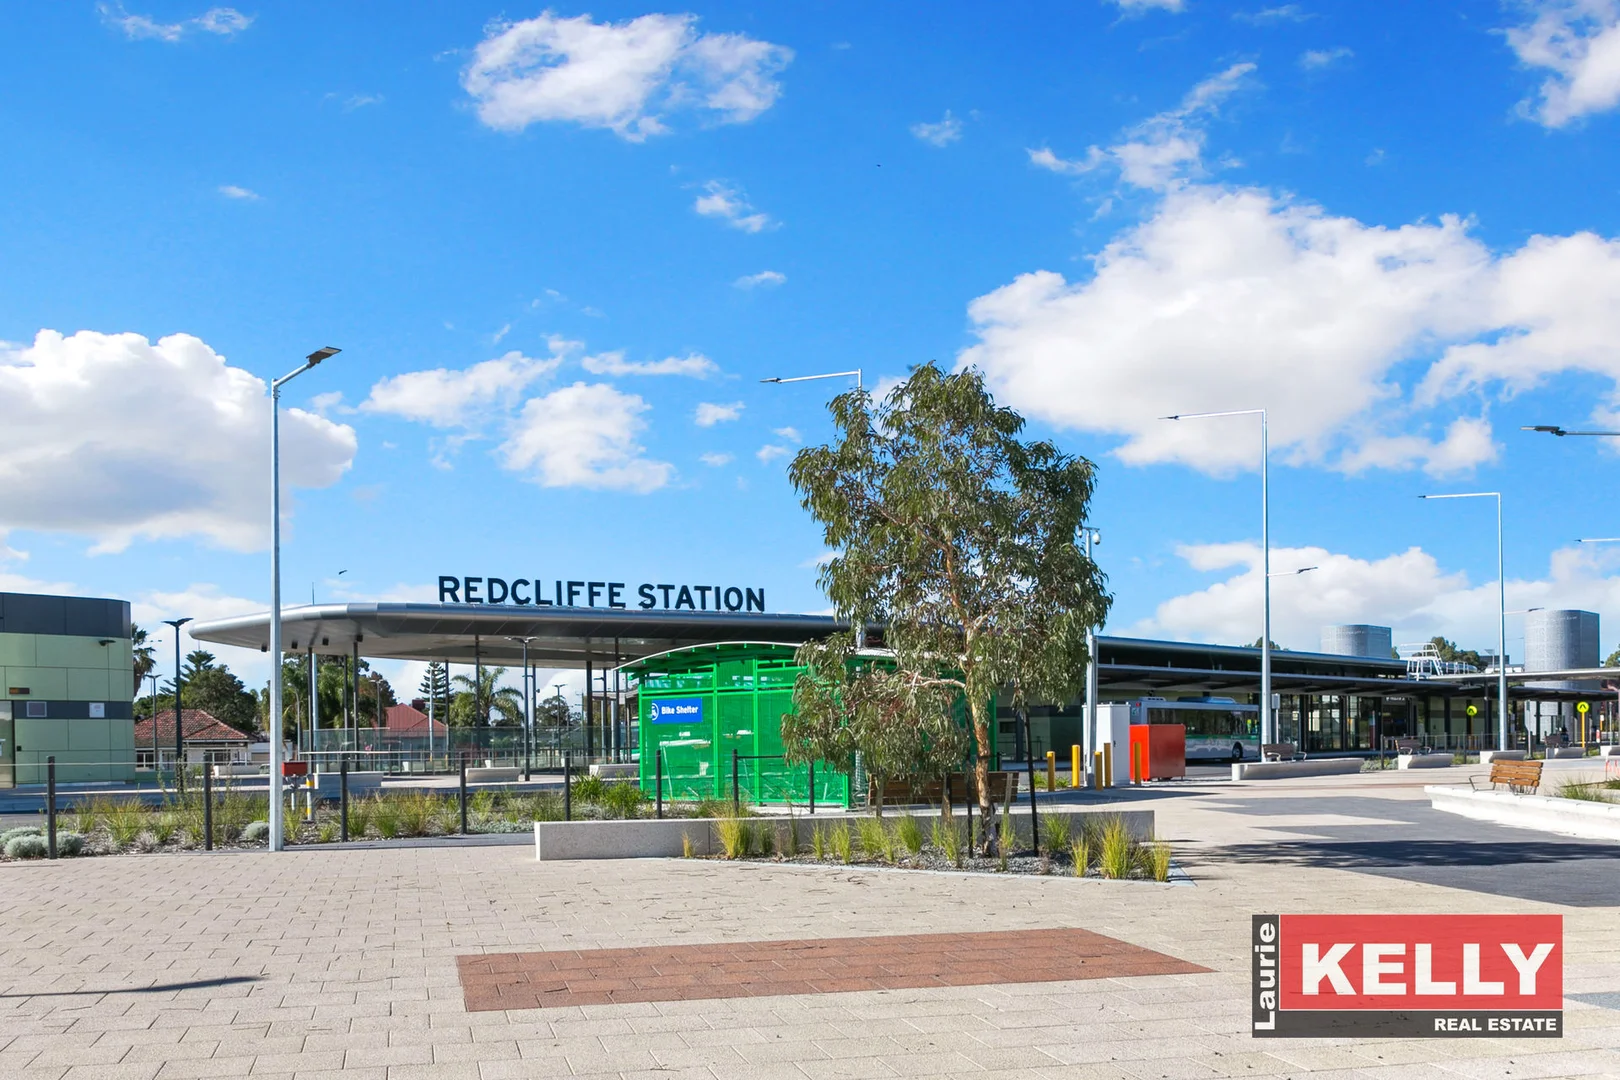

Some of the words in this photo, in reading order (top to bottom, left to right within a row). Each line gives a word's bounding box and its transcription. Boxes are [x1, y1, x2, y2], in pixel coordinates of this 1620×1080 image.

[438, 576, 626, 608] REDCLIFFE
[638, 583, 765, 612] STATION
[661, 706, 675, 715] Bike
[676, 705, 699, 714] Shelter
